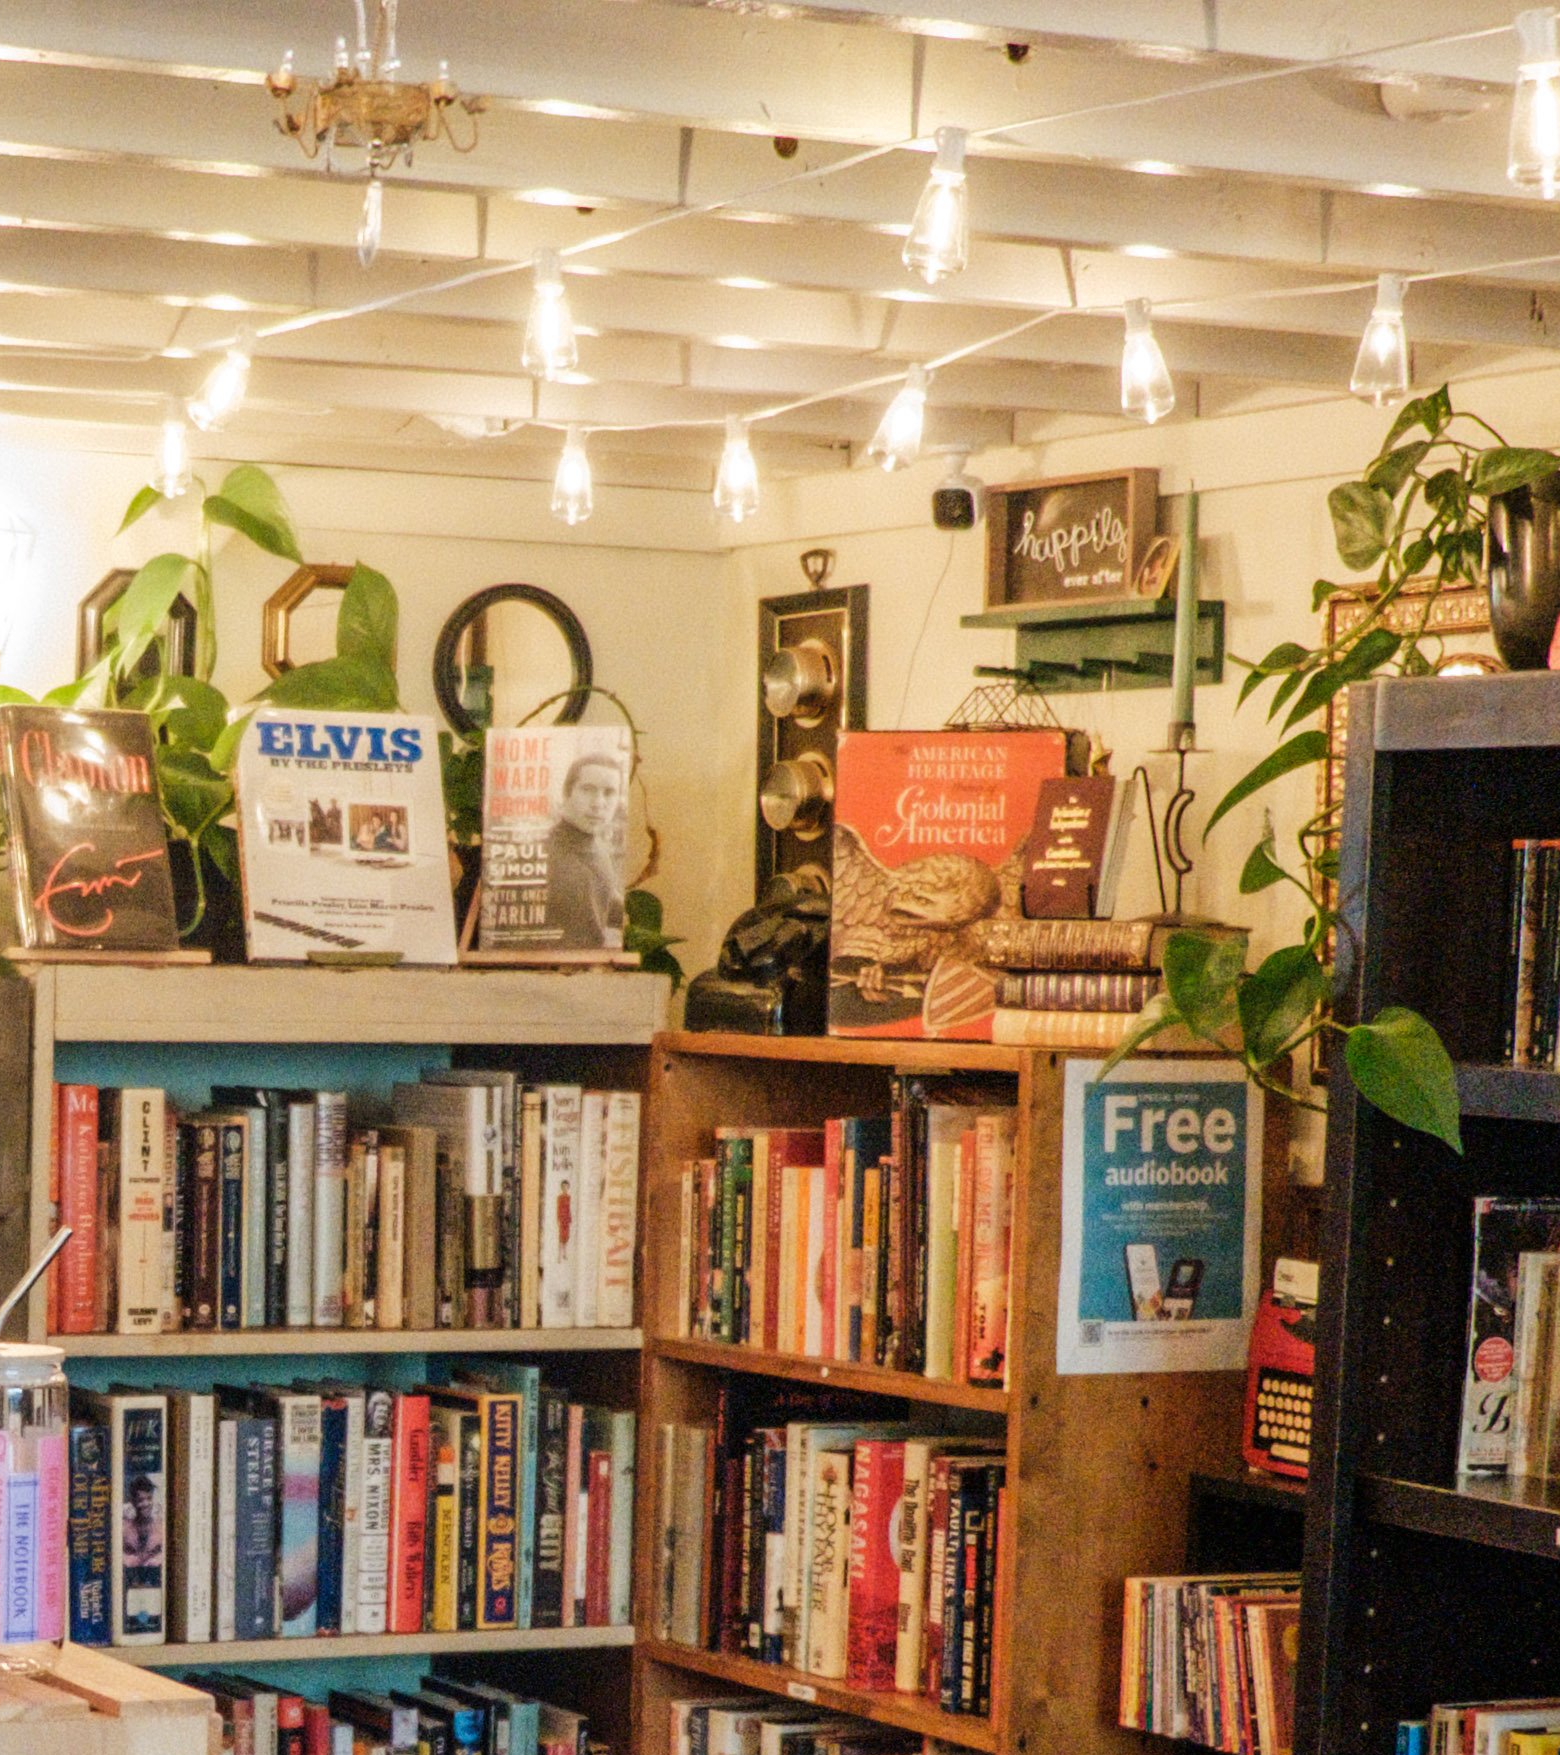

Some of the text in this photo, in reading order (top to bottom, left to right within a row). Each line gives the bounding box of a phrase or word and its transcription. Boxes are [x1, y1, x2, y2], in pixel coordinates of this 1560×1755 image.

[1013, 506, 1129, 572] happily
[1063, 571, 1124, 588] ever after
[257, 721, 423, 764] ELVIS
[270, 759, 414, 774] BY THE PRESLEYS
[493, 737, 551, 762] HOME
[908, 746, 1008, 763] AMERICAN
[492, 766, 551, 790] WARD
[907, 763, 1008, 780] HERITAGE
[895, 784, 1006, 828] Colonial
[489, 843, 549, 861] PAUL
[874, 815, 1006, 848] America
[488, 861, 549, 879] SIMON
[486, 904, 547, 927] CARLIN
[141, 1101, 152, 1173] CLINT
[1102, 1095, 1237, 1154] Free
[1104, 1160, 1229, 1188] audiobook
[75, 1123, 94, 1297] Katharine Hepburn
[605, 1118, 634, 1291] FISHBAIT
[246, 1437, 260, 1497] STEEL
[261, 1426, 275, 1488] GRACE
[407, 1428, 425, 1484] Gambler
[493, 1403, 512, 1509] KITTY KELLEY
[365, 1443, 380, 1530] MRS. NIXON
[904, 1478, 920, 1498] The
[70, 1473, 91, 1561] OUR TIME
[405, 1521, 422, 1548] Billy
[849, 1445, 871, 1581] NAGASAKI
[10, 1504, 30, 1620] THE NOTEBOOK
[92, 1540, 106, 1573] FOR
[440, 1509, 452, 1585] MENCKEN
[810, 1493, 830, 1614] THY FATHER
[824, 1503, 839, 1574] HONOR
